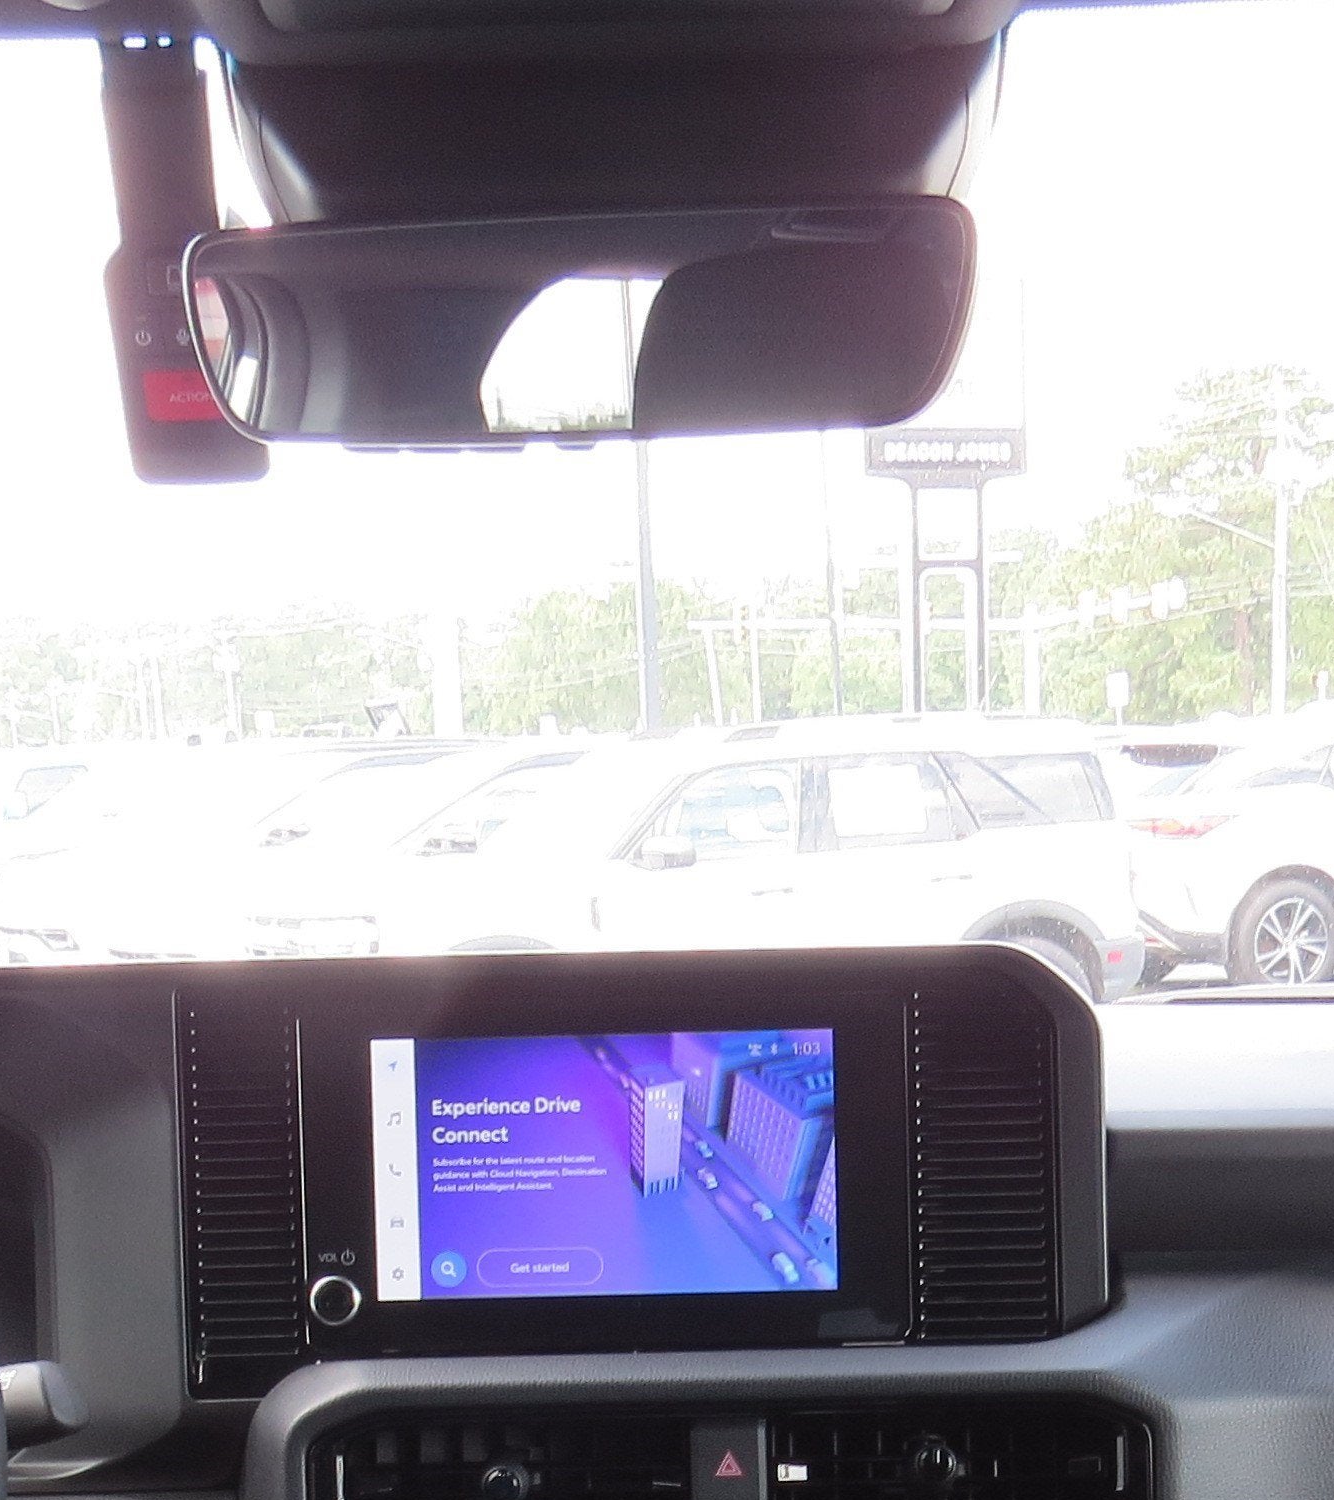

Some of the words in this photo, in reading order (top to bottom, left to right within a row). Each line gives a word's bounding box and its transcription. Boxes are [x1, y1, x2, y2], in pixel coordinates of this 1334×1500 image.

[792, 1041, 821, 1055] 1:03
[431, 1097, 531, 1119] Experience
[534, 1095, 582, 1114] Drive
[431, 1127, 509, 1144] Connect
[546, 1155, 562, 1164] and
[490, 1169, 514, 1178] Cloud
[458, 1183, 473, 1192] and
[509, 1262, 530, 1274] Get
[532, 1261, 570, 1273] started
